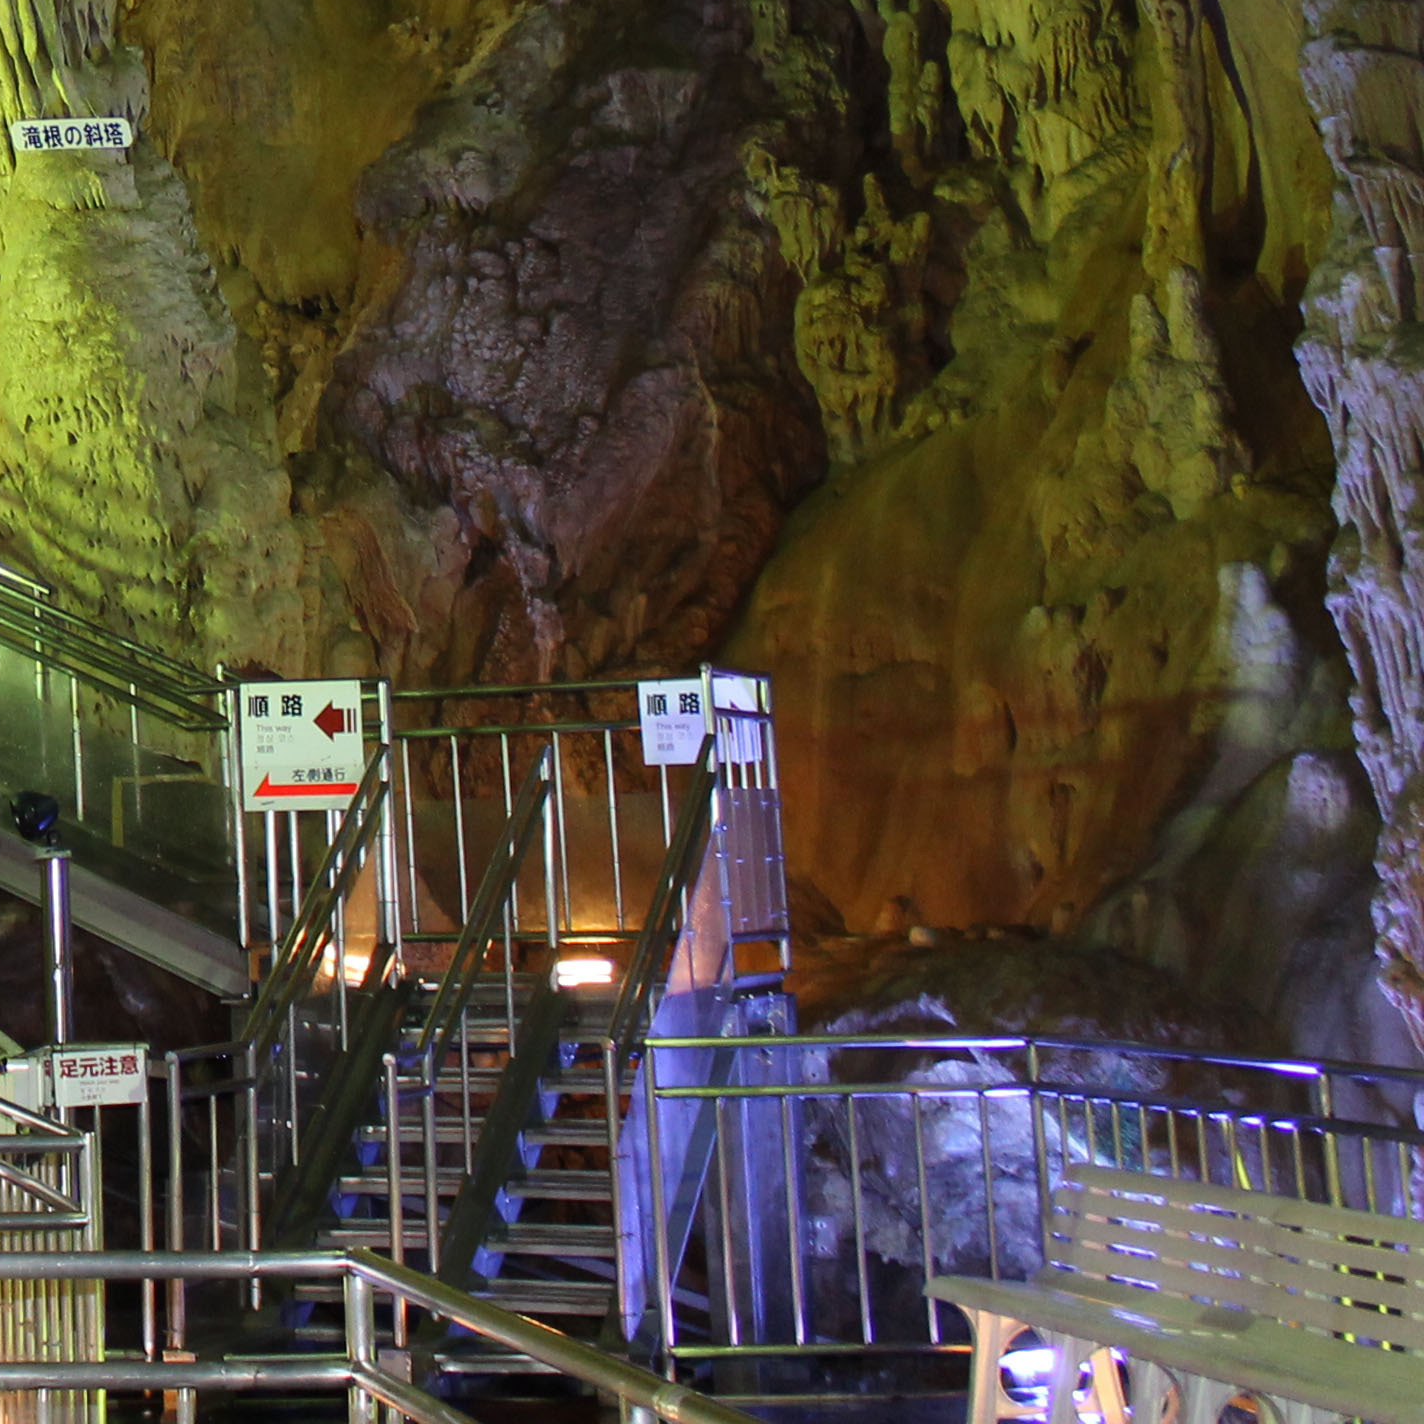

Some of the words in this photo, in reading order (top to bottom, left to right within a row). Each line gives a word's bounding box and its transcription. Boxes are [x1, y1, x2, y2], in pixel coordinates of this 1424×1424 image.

[22, 122, 124, 149] 滝根の斜塔
[248, 694, 303, 717] 順路
[646, 692, 700, 716] 順路
[291, 767, 346, 783] 左側通行
[59, 1055, 140, 1079] 足元注意
